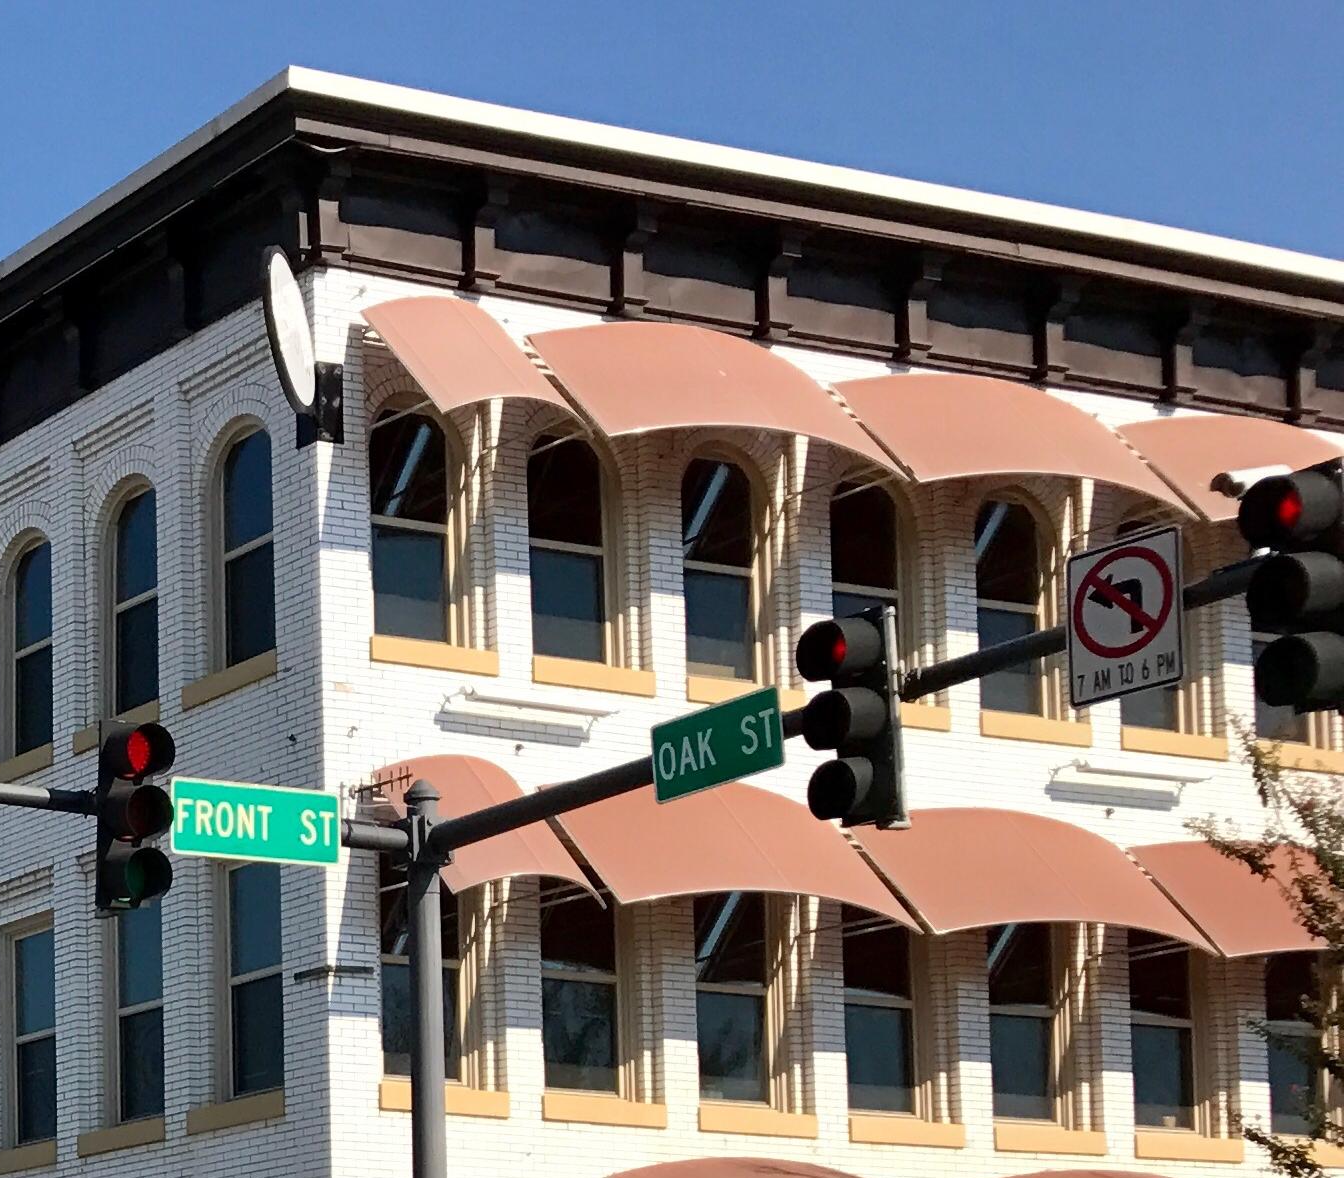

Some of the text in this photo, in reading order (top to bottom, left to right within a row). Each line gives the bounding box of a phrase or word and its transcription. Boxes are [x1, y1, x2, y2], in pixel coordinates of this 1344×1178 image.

[1077, 651, 1175, 697] 7 AM TO 6 PM
[658, 707, 775, 781] OAK ST
[177, 798, 335, 847] FRONT ST
